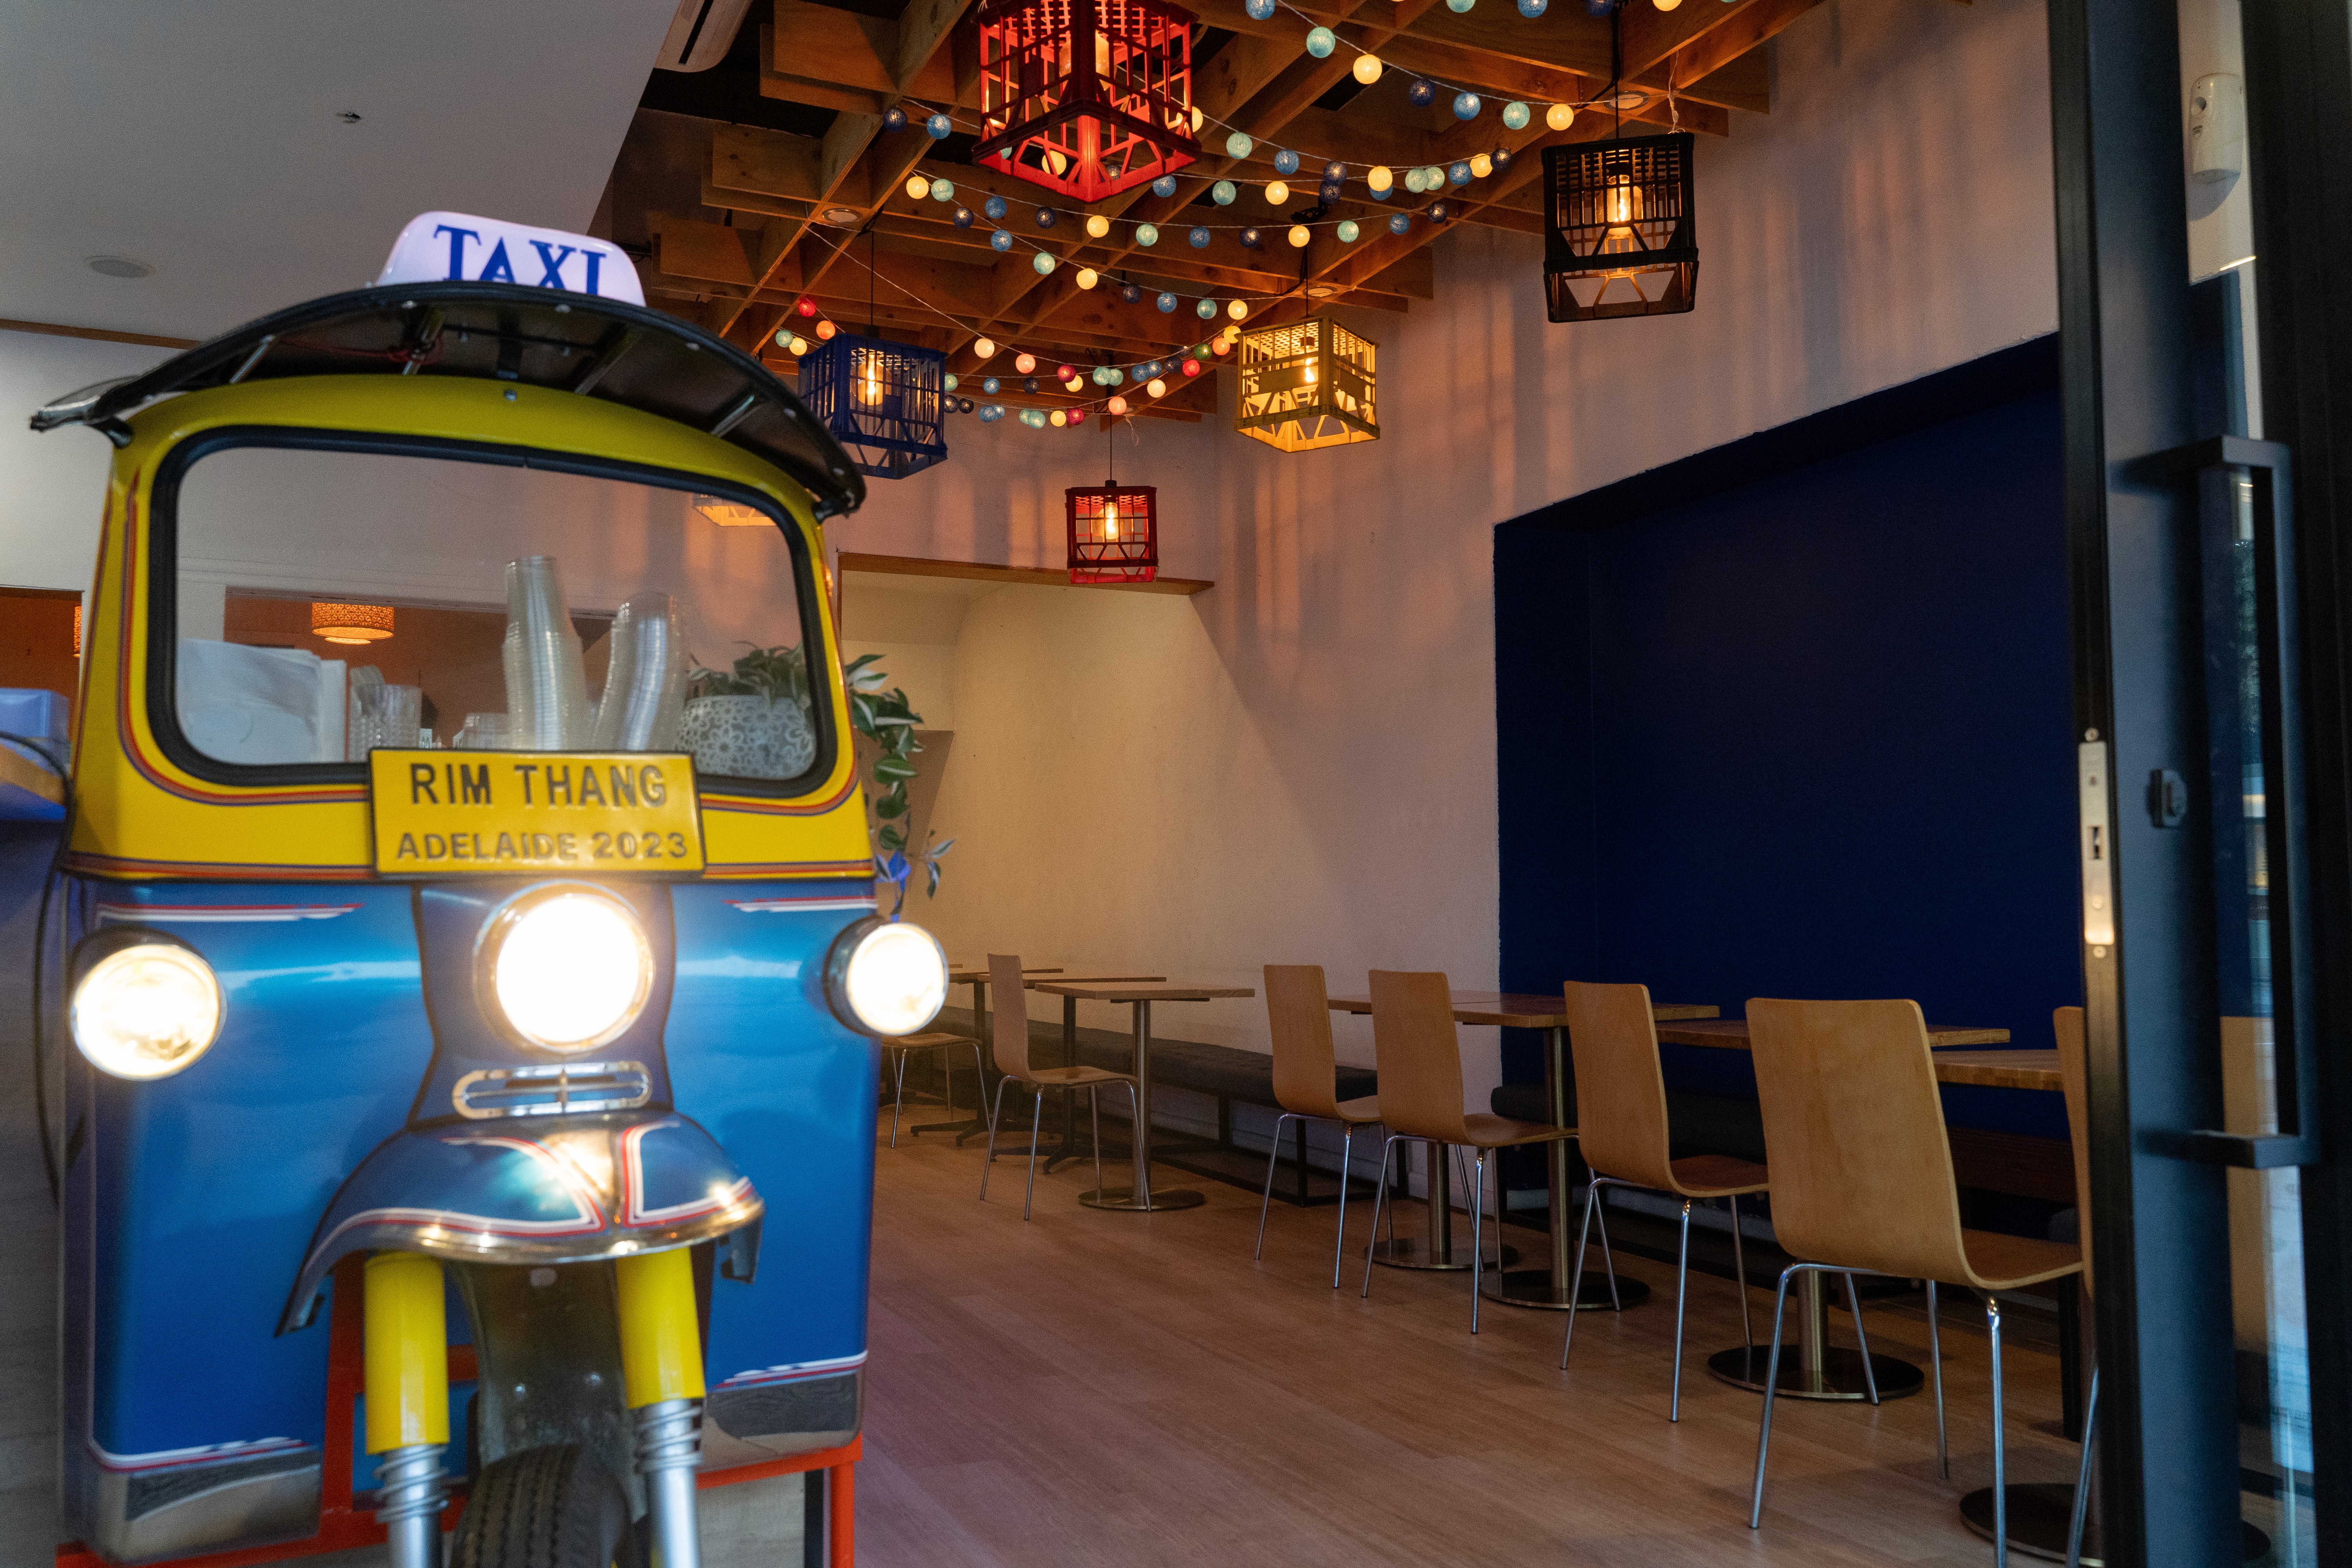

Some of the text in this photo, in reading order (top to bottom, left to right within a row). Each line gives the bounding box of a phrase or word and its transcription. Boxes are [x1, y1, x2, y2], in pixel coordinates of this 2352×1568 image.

[433, 224, 606, 295] TAXI
[410, 763, 666, 808] RIM THANG
[396, 831, 687, 861] ADELAIDE 2023
